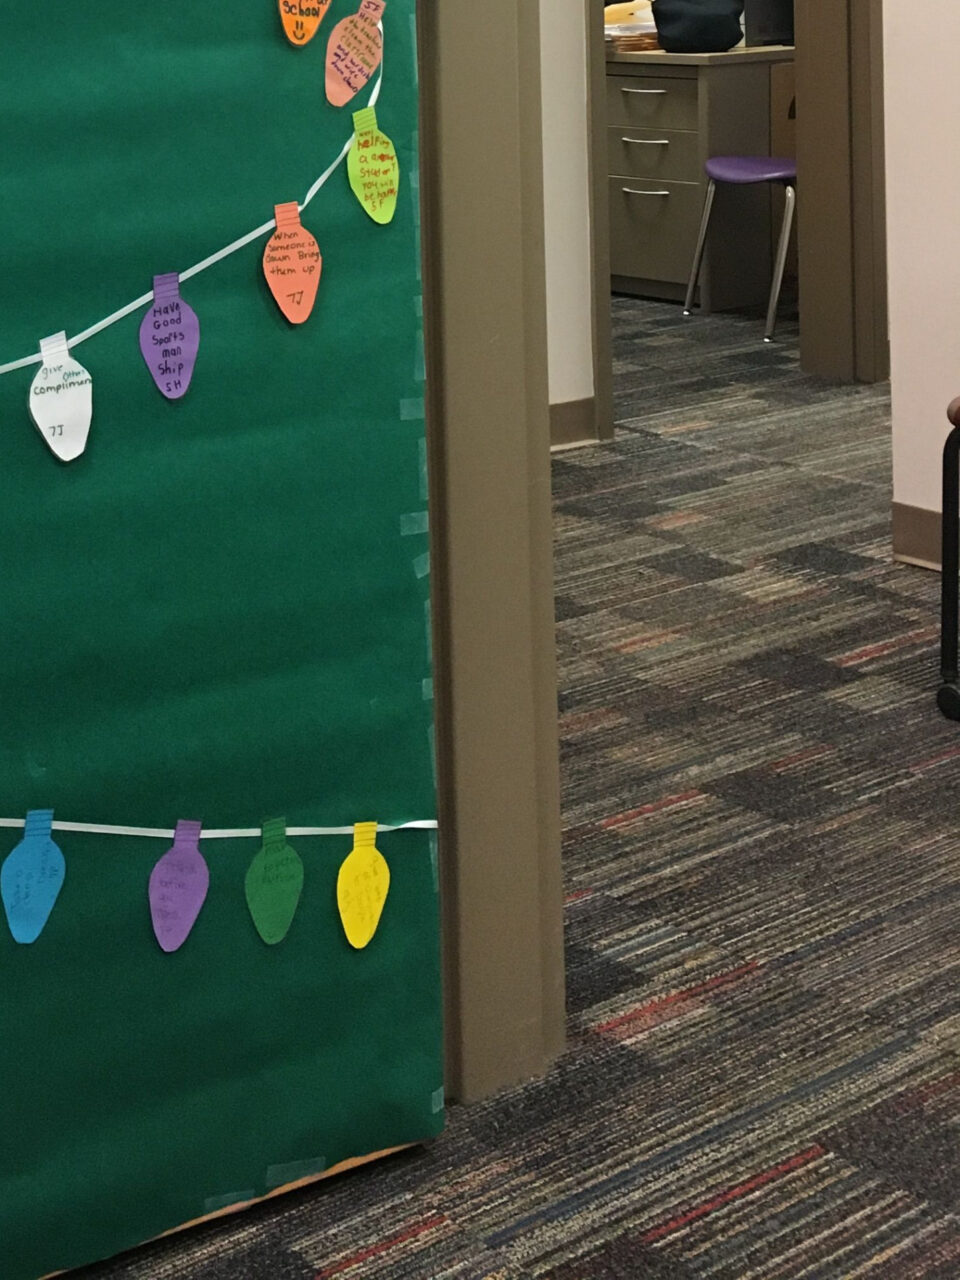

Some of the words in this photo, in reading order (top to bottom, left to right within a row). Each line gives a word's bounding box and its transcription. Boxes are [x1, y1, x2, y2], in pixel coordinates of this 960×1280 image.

[273, 232, 298, 241] When
[298, 251, 320, 262] Bring
[270, 267, 296, 275] them
[286, 291, 304, 305] 7J
[153, 302, 181, 318] Have
[153, 313, 182, 330] Good
[162, 346, 182, 359] man
[49, 425, 64, 437] 7J
